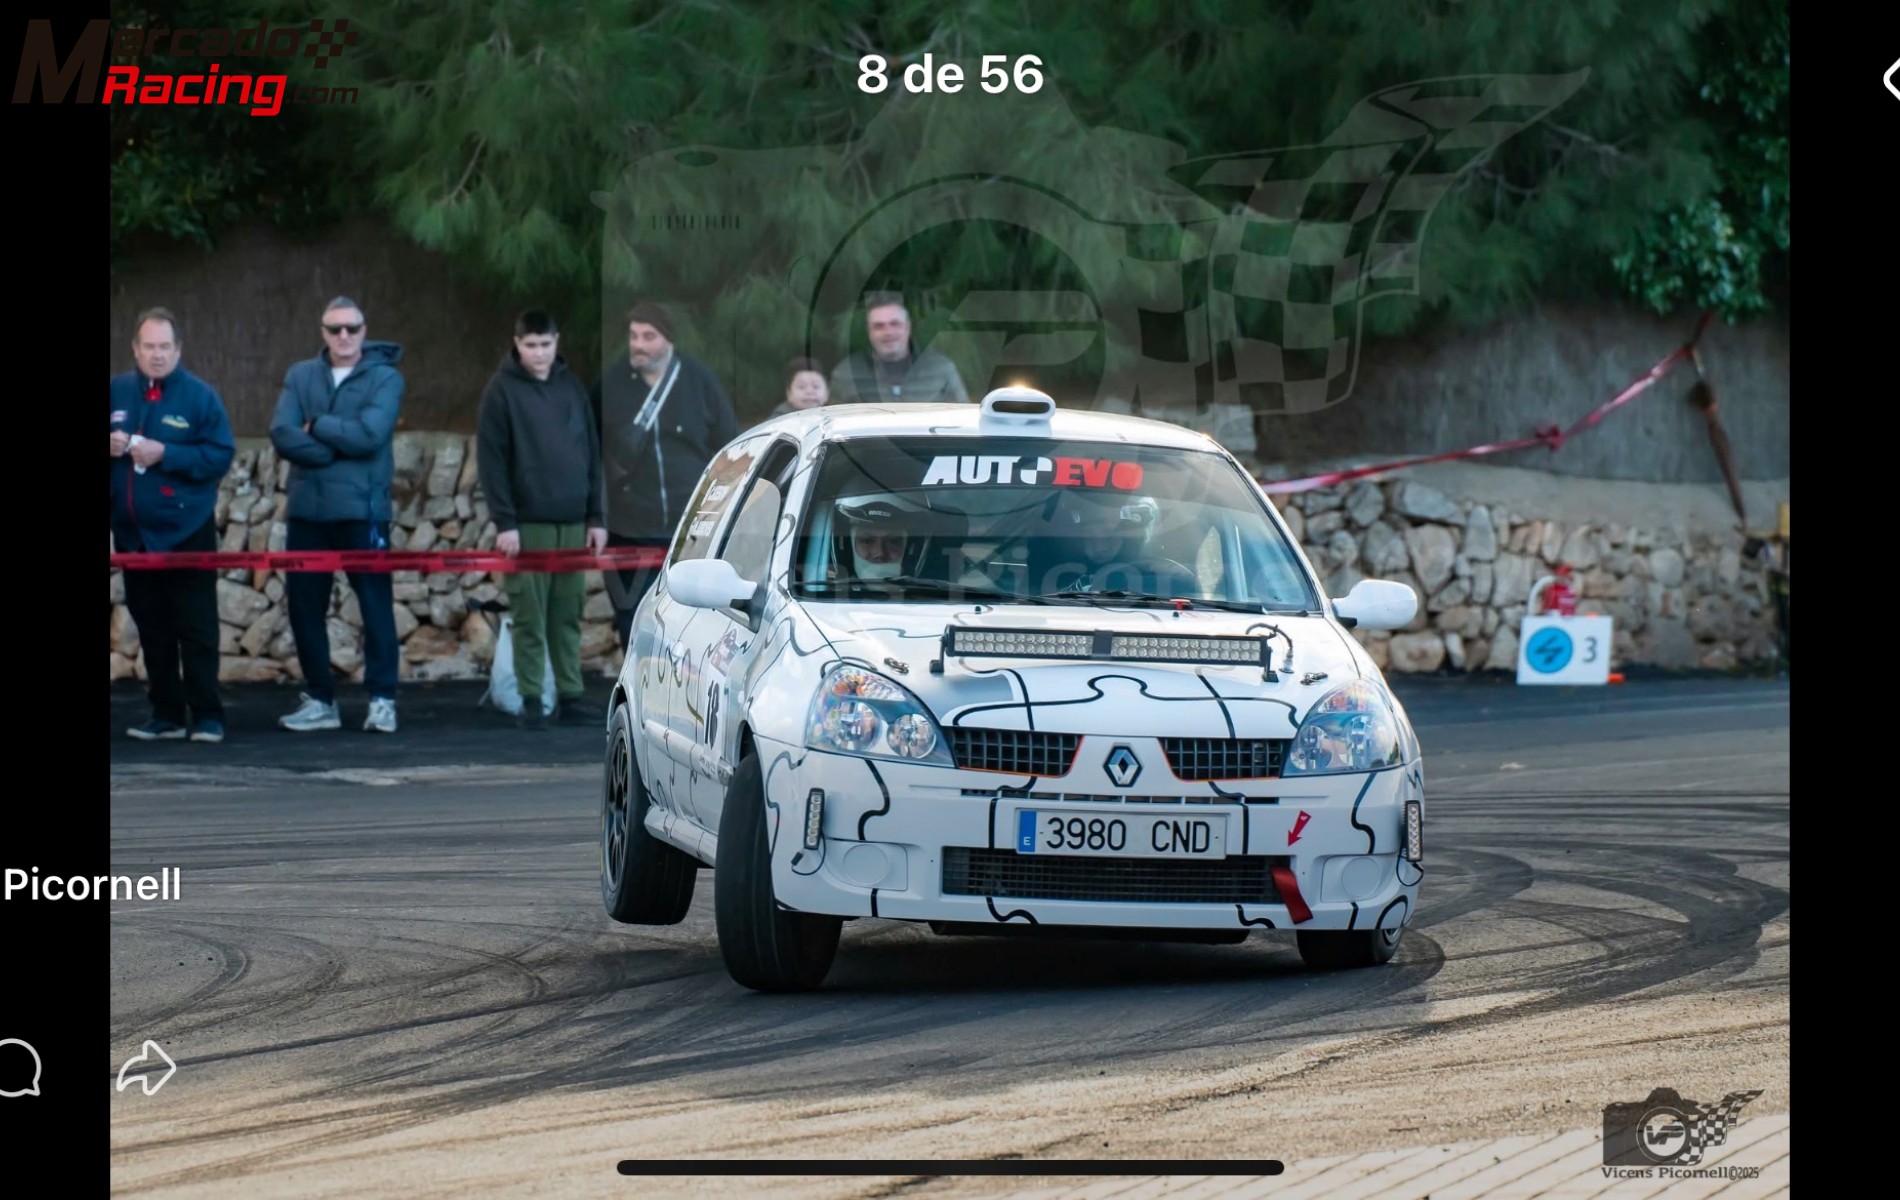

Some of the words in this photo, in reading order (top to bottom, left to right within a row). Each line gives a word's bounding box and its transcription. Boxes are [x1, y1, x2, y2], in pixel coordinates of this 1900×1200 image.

[1582, 636, 1598, 663] 3
[1023, 836, 1032, 846] E
[1046, 817, 1127, 851] 3980
[1151, 820, 1211, 853] CND
